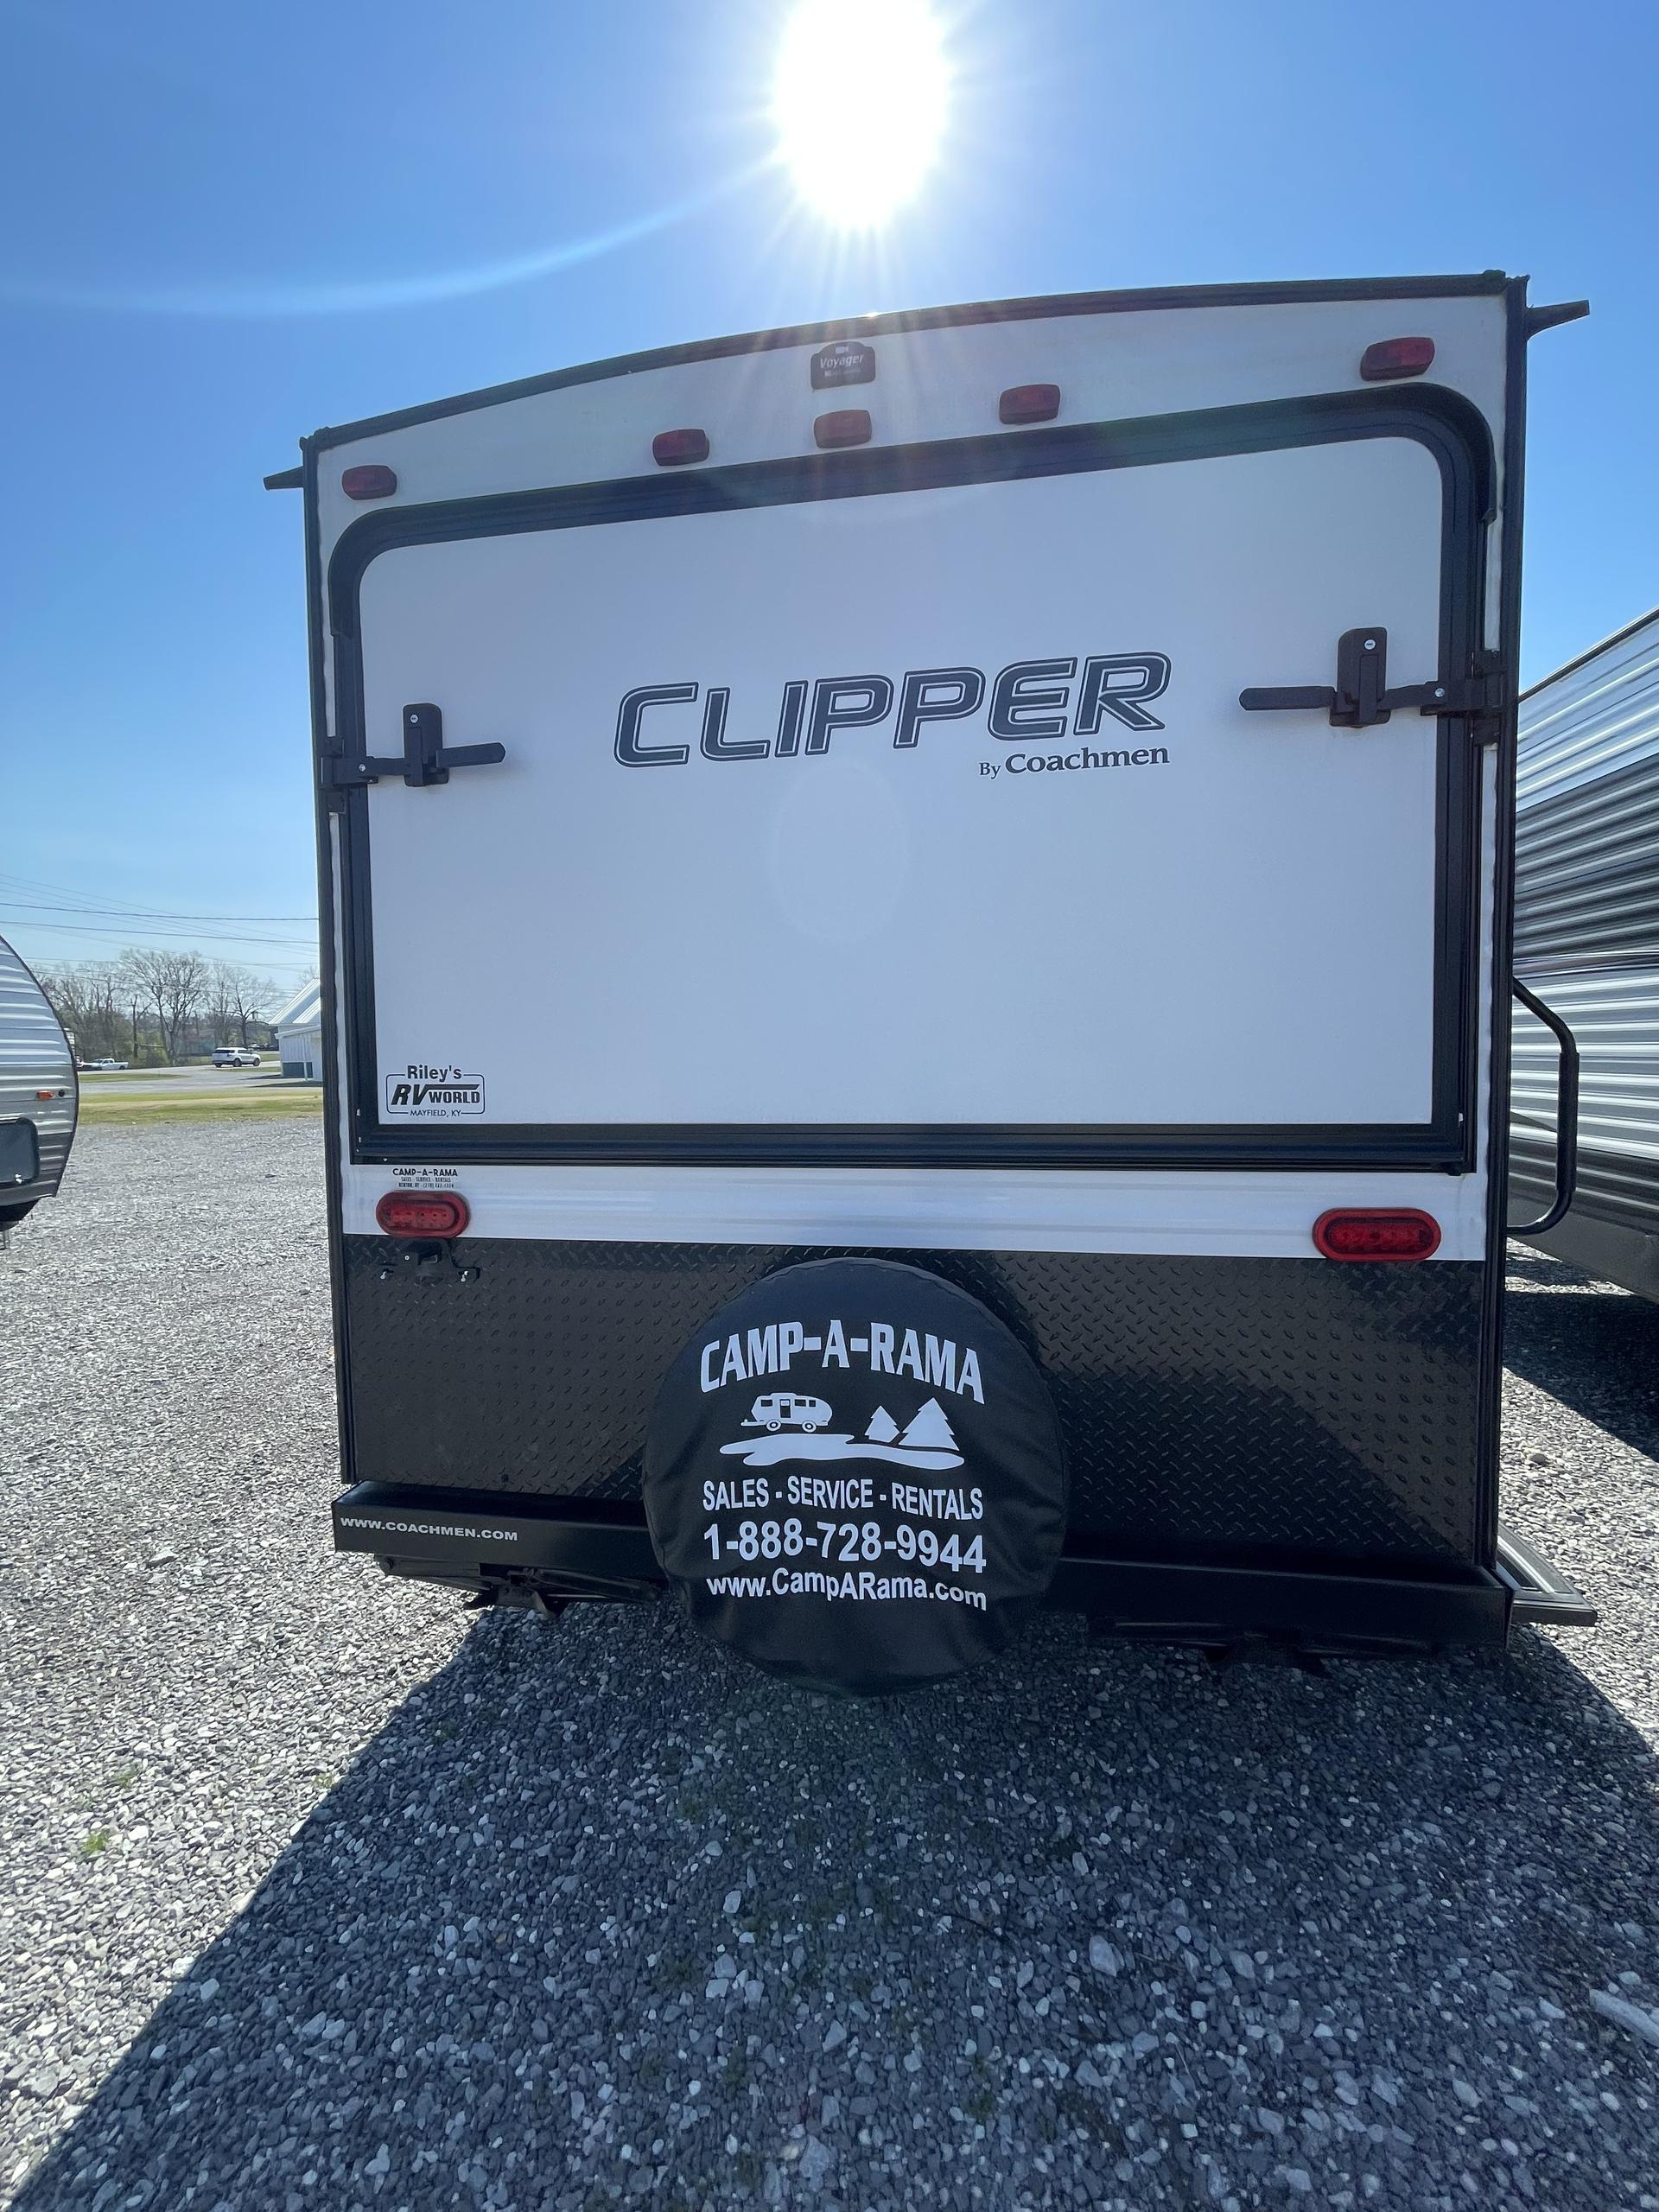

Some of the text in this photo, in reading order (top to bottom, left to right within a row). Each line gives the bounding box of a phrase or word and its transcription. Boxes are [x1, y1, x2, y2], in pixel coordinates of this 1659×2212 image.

[820, 354, 864, 369] Voyager
[614, 651, 1172, 768] CLIPPER
[979, 747, 1170, 779] By Coachmen
[407, 1065, 462, 1082] Riley's
[391, 1084, 480, 1106] RV WORLD
[410, 1109, 448, 1118] MAYFIELD,
[392, 1168, 458, 1177] CAMP-A-RAMA
[700, 1319, 985, 1405] CAMP-A-RAMA
[702, 1477, 769, 1511] SALES
[787, 1475, 874, 1510] SERVICE
[892, 1482, 983, 1520] RENTALS
[340, 1516, 518, 1541] WWW.COACHMEN.COM
[703, 1518, 987, 1573] 1-888-728-9944
[706, 1567, 987, 1611] www.CampARama.com
